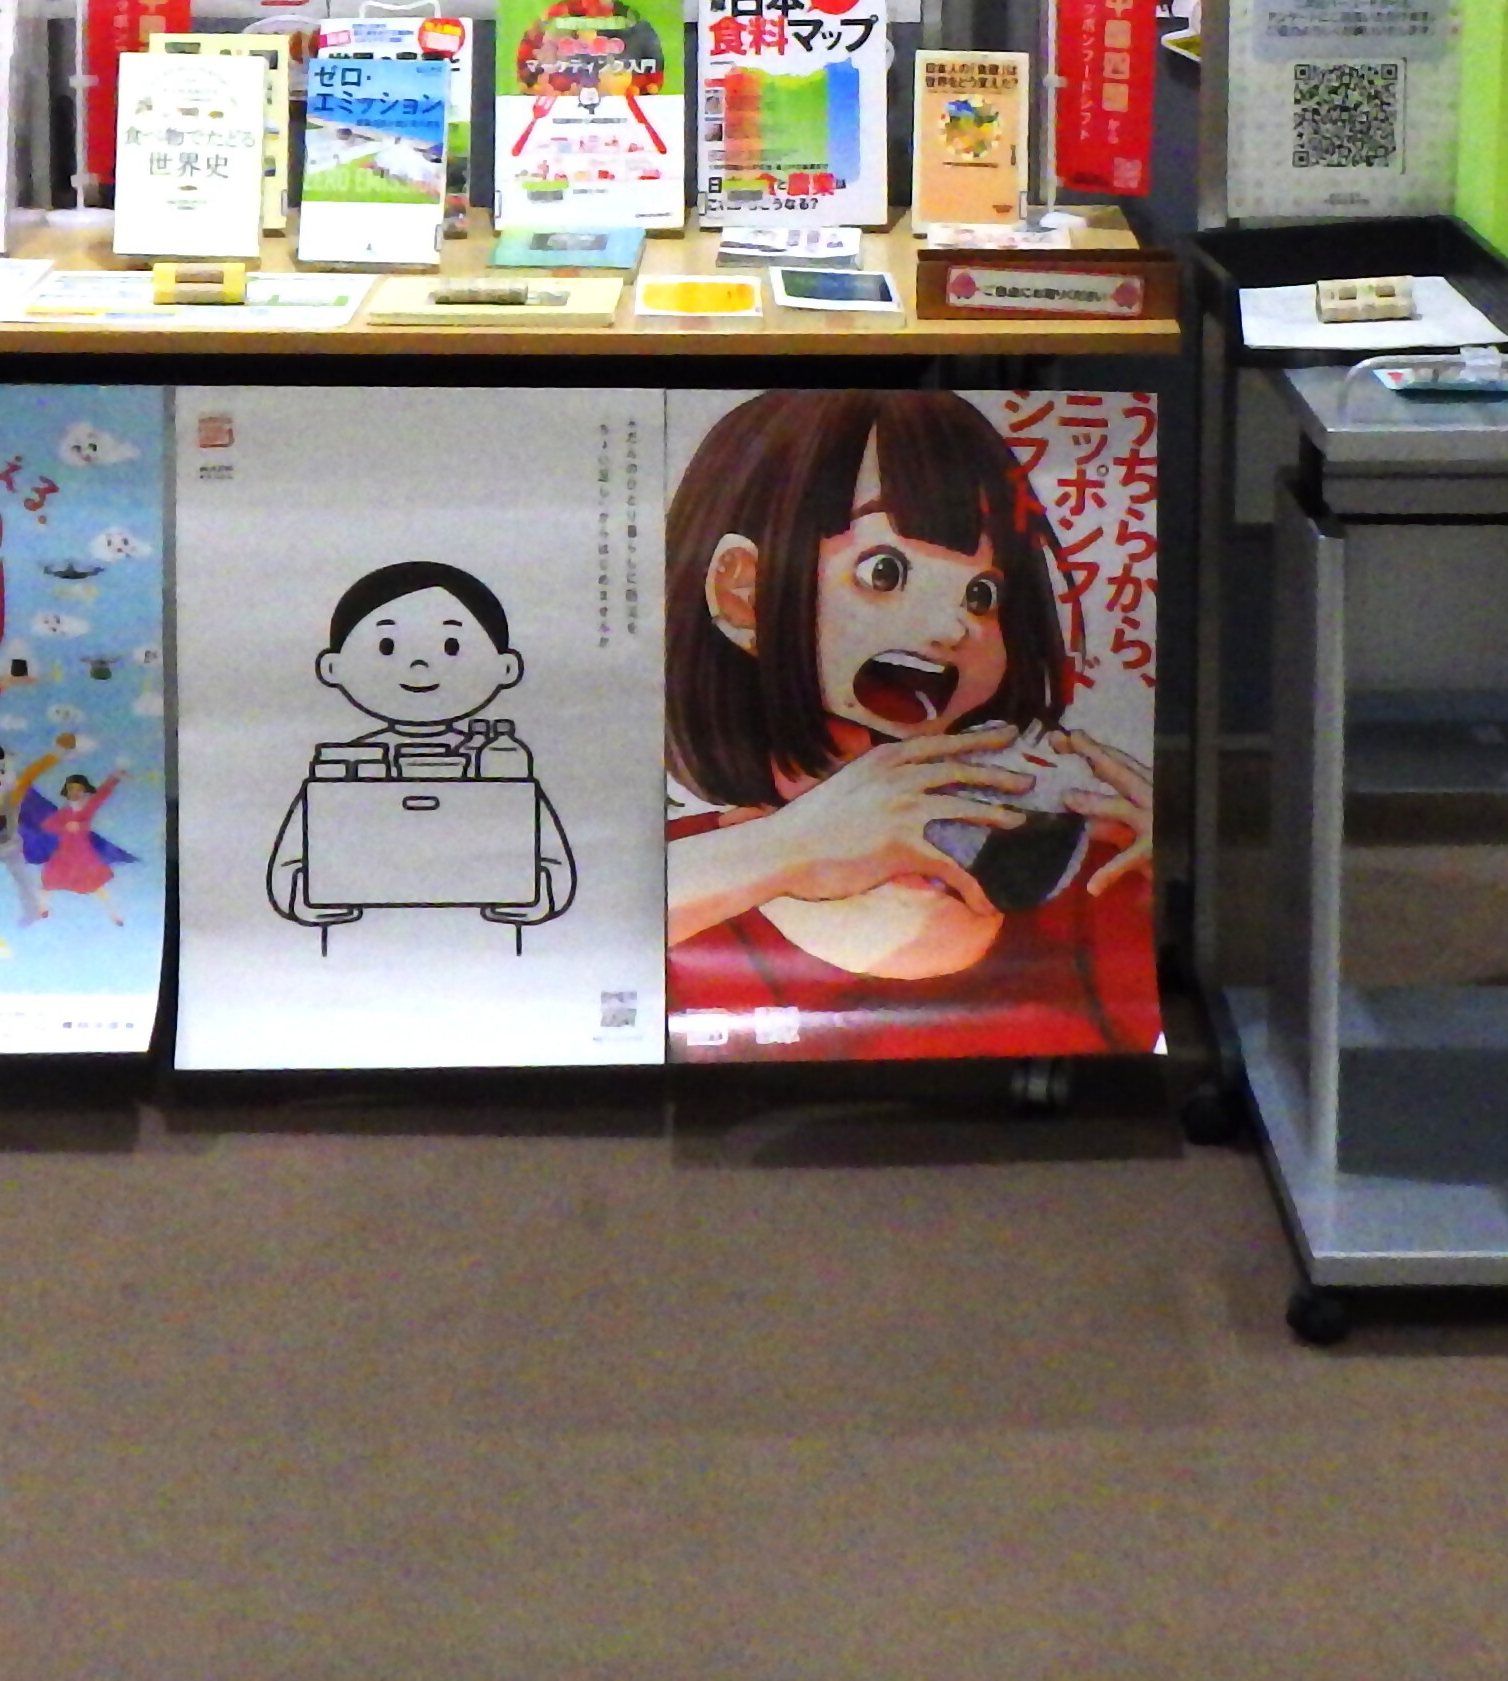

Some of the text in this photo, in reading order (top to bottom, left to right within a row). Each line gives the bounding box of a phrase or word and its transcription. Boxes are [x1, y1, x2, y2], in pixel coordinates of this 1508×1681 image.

[709, 14, 880, 56] 食料マップ
[315, 90, 443, 115] エミッション
[149, 152, 230, 180] 世界史
